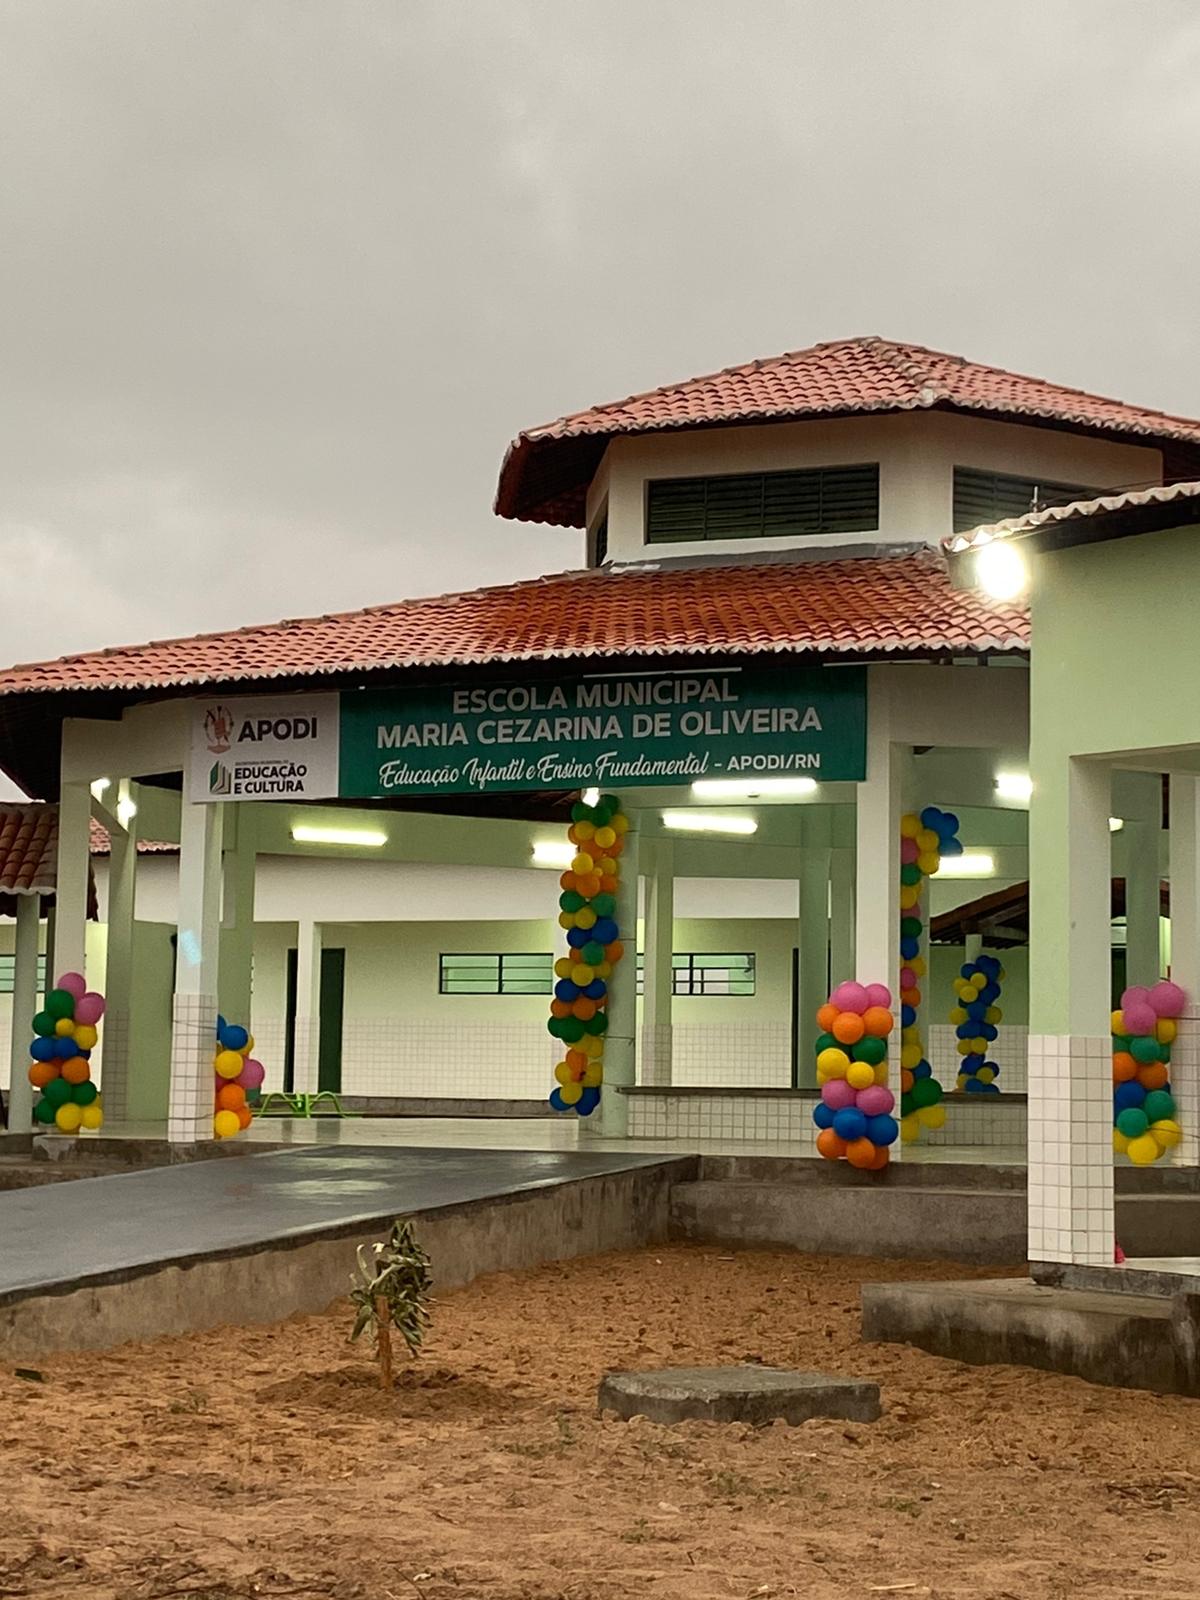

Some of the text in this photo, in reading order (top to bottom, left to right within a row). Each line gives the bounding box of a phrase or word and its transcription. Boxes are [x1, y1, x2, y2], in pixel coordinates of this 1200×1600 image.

[452, 678, 739, 715] ESCOLA MUNICIPAL
[237, 717, 318, 743] APODI
[377, 706, 822, 749] MARIA CEZARINA DE OLIVEIRA
[234, 763, 308, 780] EDUCAÇÃO
[378, 759, 460, 789] Educação
[462, 757, 525, 790] Infantil
[525, 767, 536, 780] e
[537, 753, 593, 783] Ensino
[595, 751, 710, 781] Fundamental
[727, 753, 821, 771] APODI/RN
[234, 780, 305, 795] E CULTURA
